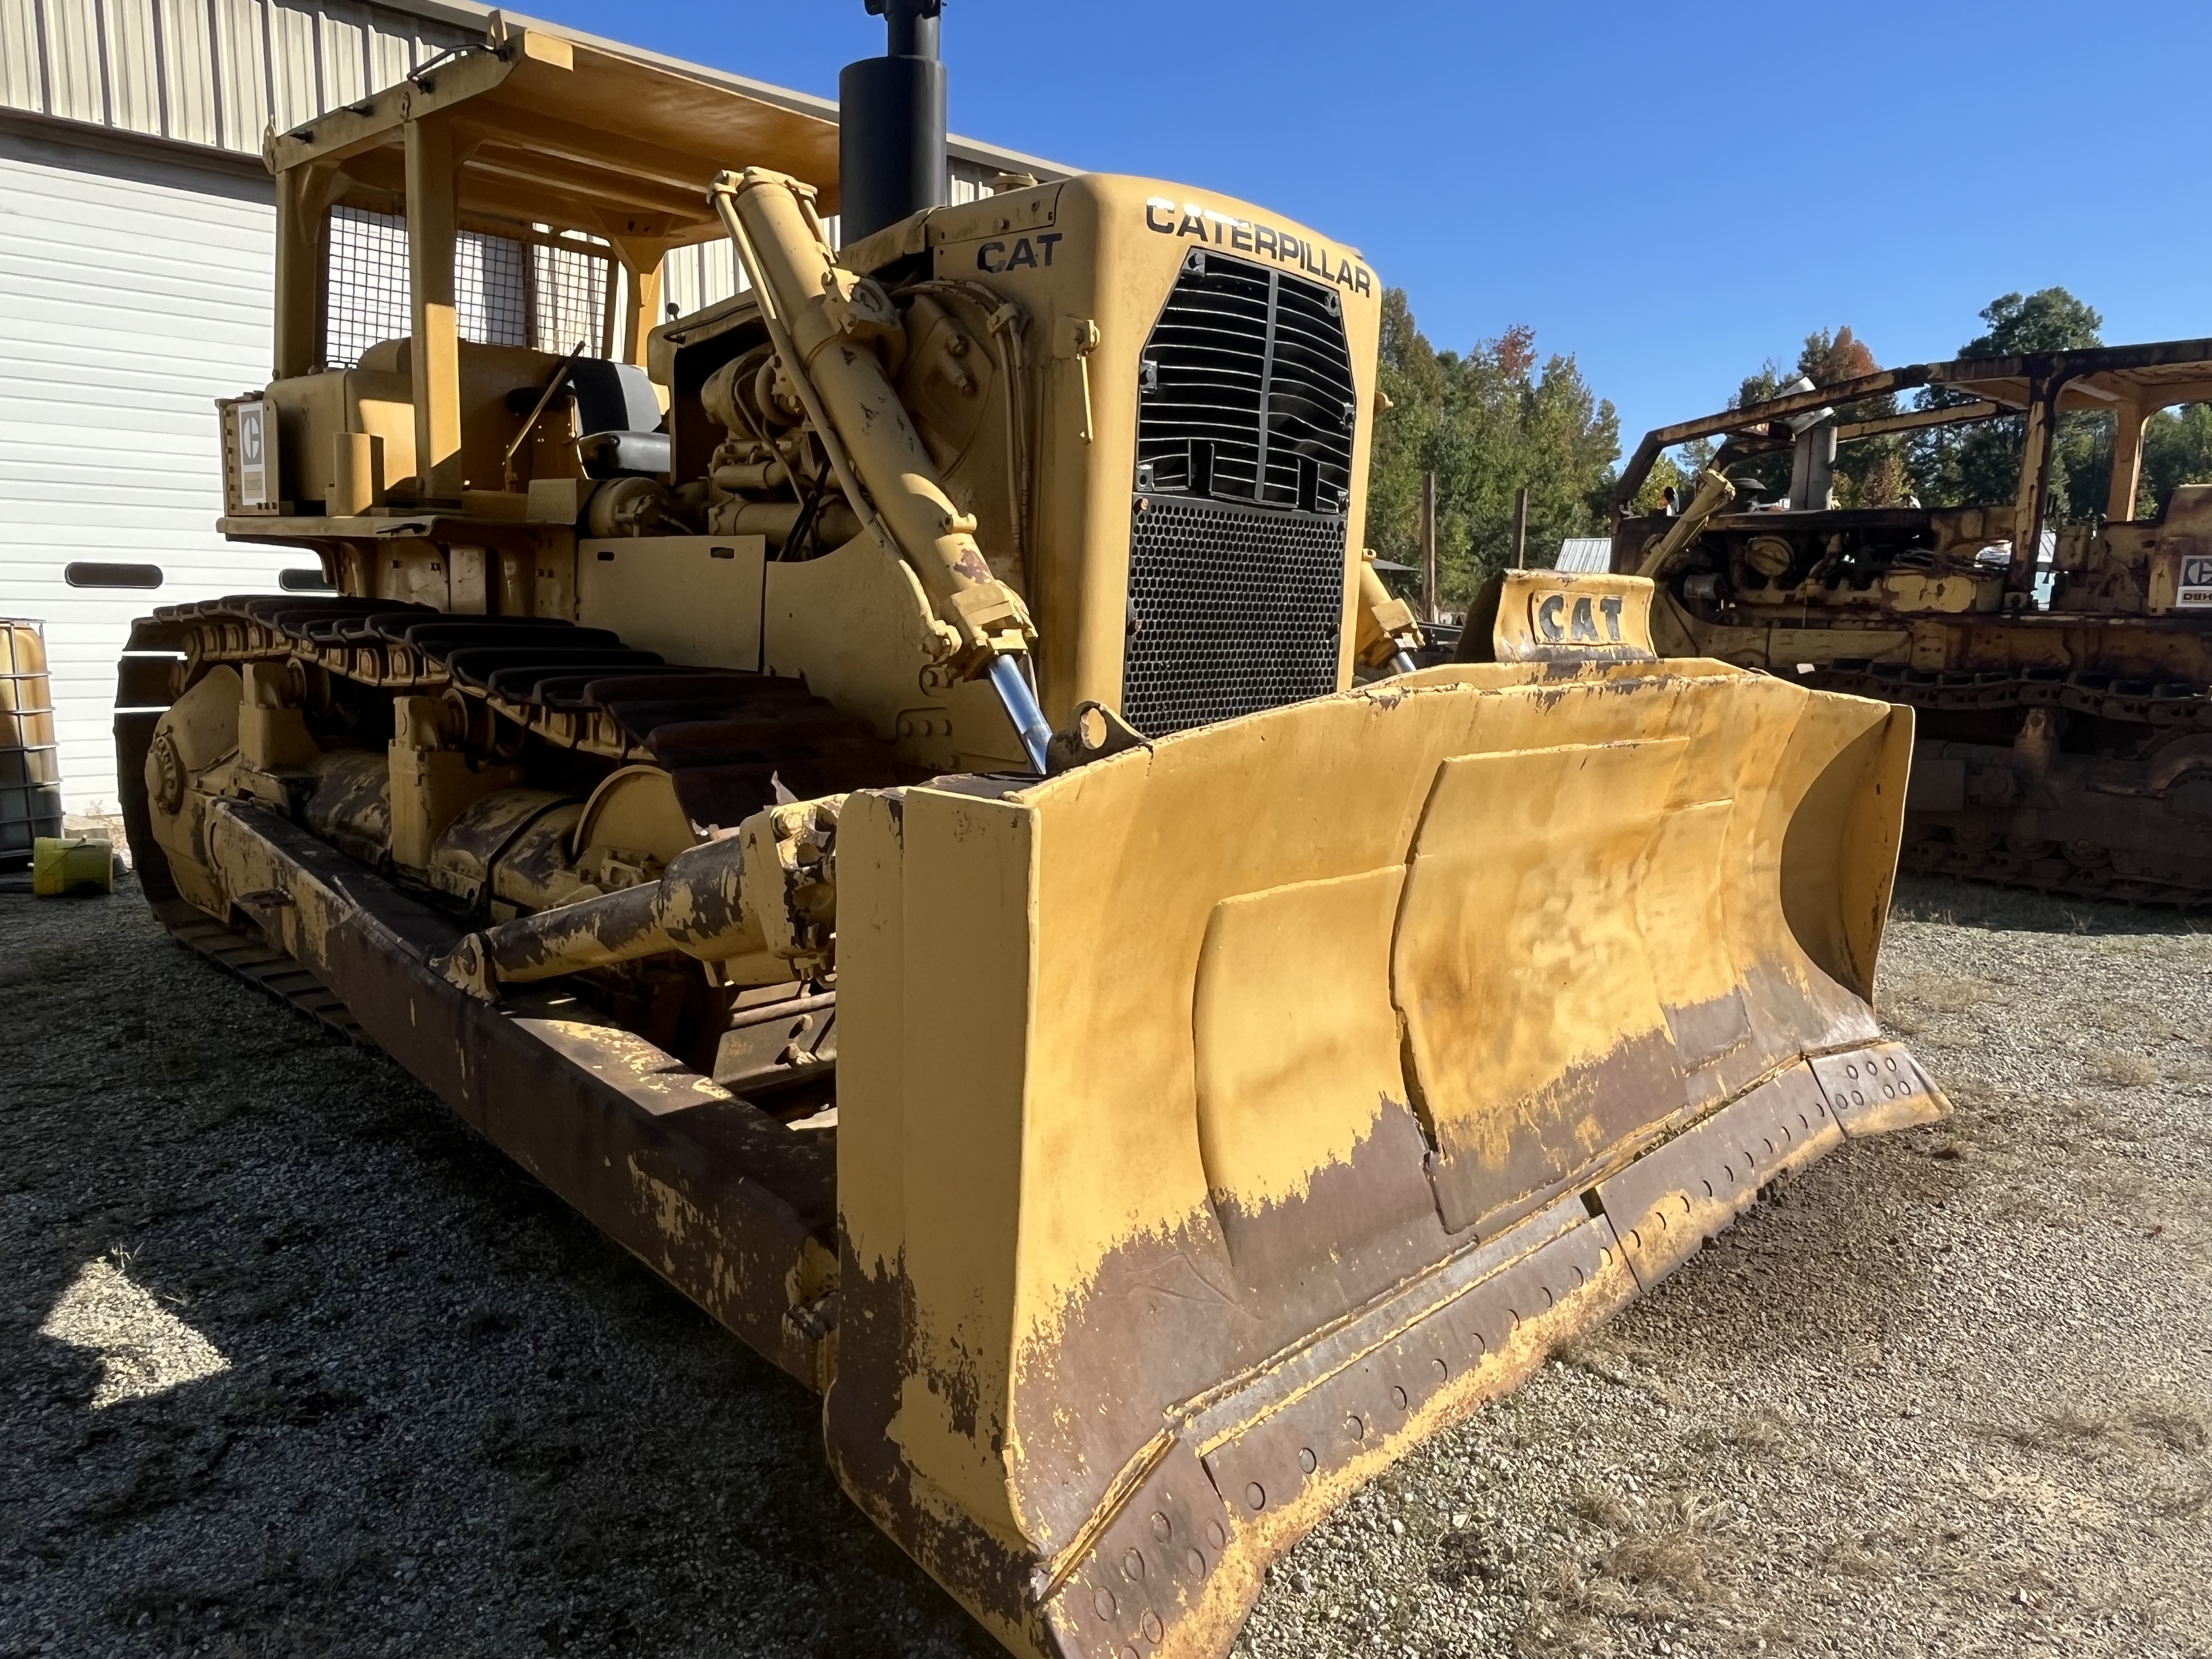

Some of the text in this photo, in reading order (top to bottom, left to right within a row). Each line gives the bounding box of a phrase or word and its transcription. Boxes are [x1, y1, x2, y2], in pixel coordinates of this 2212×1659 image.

[977, 233, 1063, 273] CAT
[1146, 199, 1370, 297] CATERPILLAR
[1539, 595, 1622, 641] CAT
